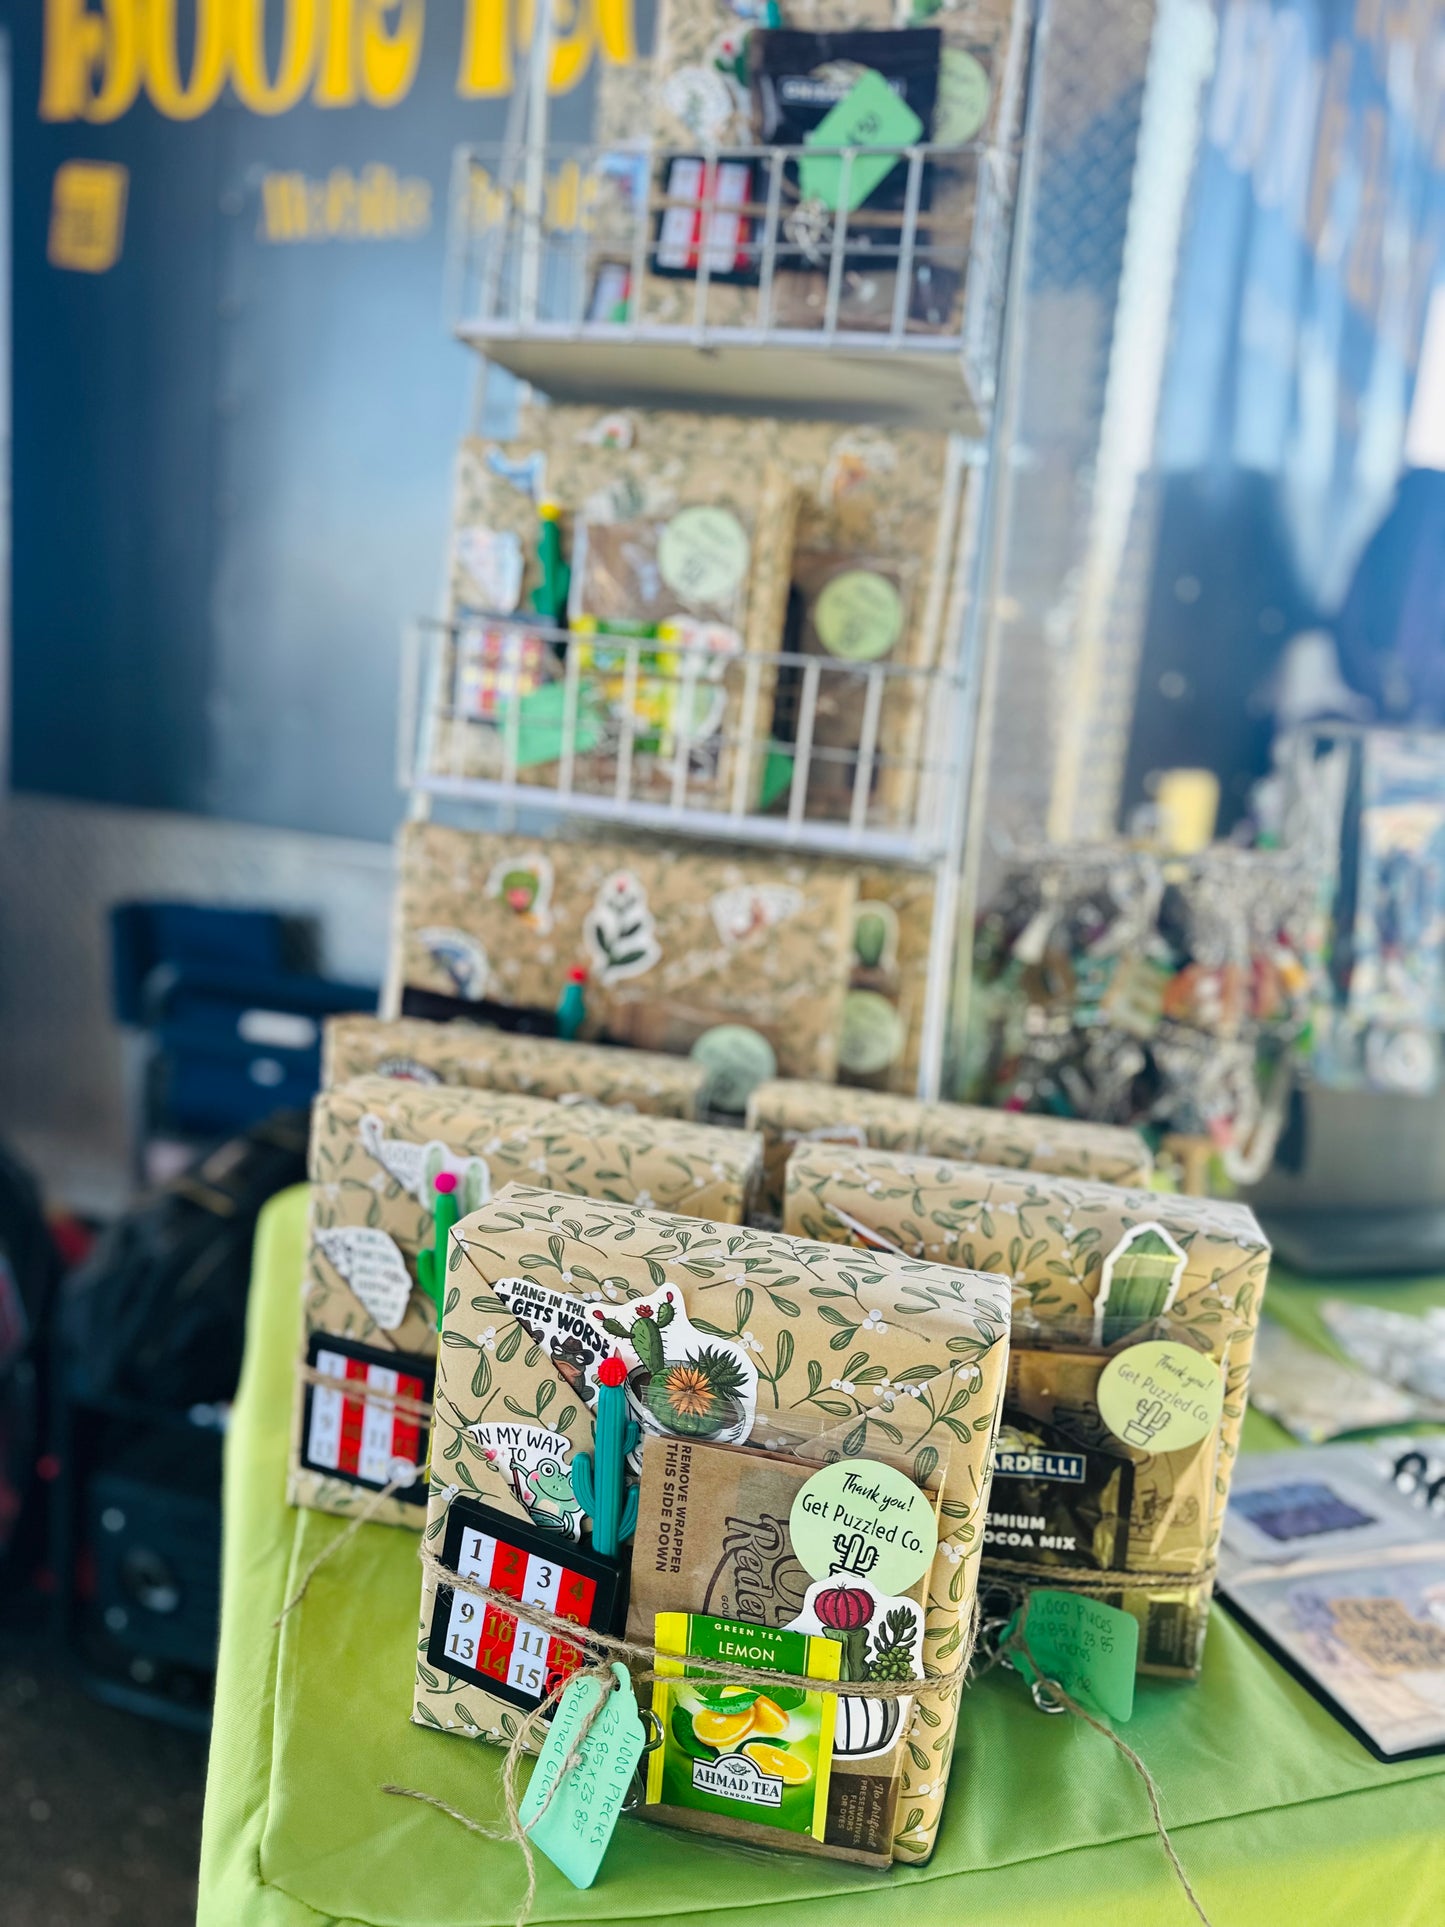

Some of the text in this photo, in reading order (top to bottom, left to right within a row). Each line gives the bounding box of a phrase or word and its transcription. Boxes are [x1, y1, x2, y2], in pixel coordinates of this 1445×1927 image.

[511, 1282, 545, 1302] HANG
[548, 1295, 562, 1309] IN
[512, 1299, 611, 1360] GETS WORSE
[1155, 1353, 1215, 1391] Thank you!
[1117, 1363, 1210, 1424] Get Puzzled Co.
[497, 1427, 522, 1445] MY
[527, 1430, 566, 1456] WAY
[508, 1447, 527, 1462] TO
[655, 1443, 679, 1573] THIS SIDE DOWN
[669, 1444, 692, 1574] REMOVE WRAPPER
[842, 1472, 915, 1512] Thank you!
[802, 1493, 924, 1554] Get Puzzled Co.
[1039, 1535, 1077, 1551] MIX
[470, 1538, 585, 1601] 1 2 3 4
[459, 1602, 579, 1672] 9 10 11 12
[714, 1623, 783, 1642] GREEN TEA
[719, 1641, 775, 1662] LEMON
[449, 1633, 541, 1689] 13 14 15
[615, 1731, 641, 1775] 1,000
[695, 1768, 780, 1798] AHMAD TEA
[719, 1789, 752, 1800] LONDON
[874, 1783, 885, 1799] No
[838, 1794, 849, 1829] OR DYES
